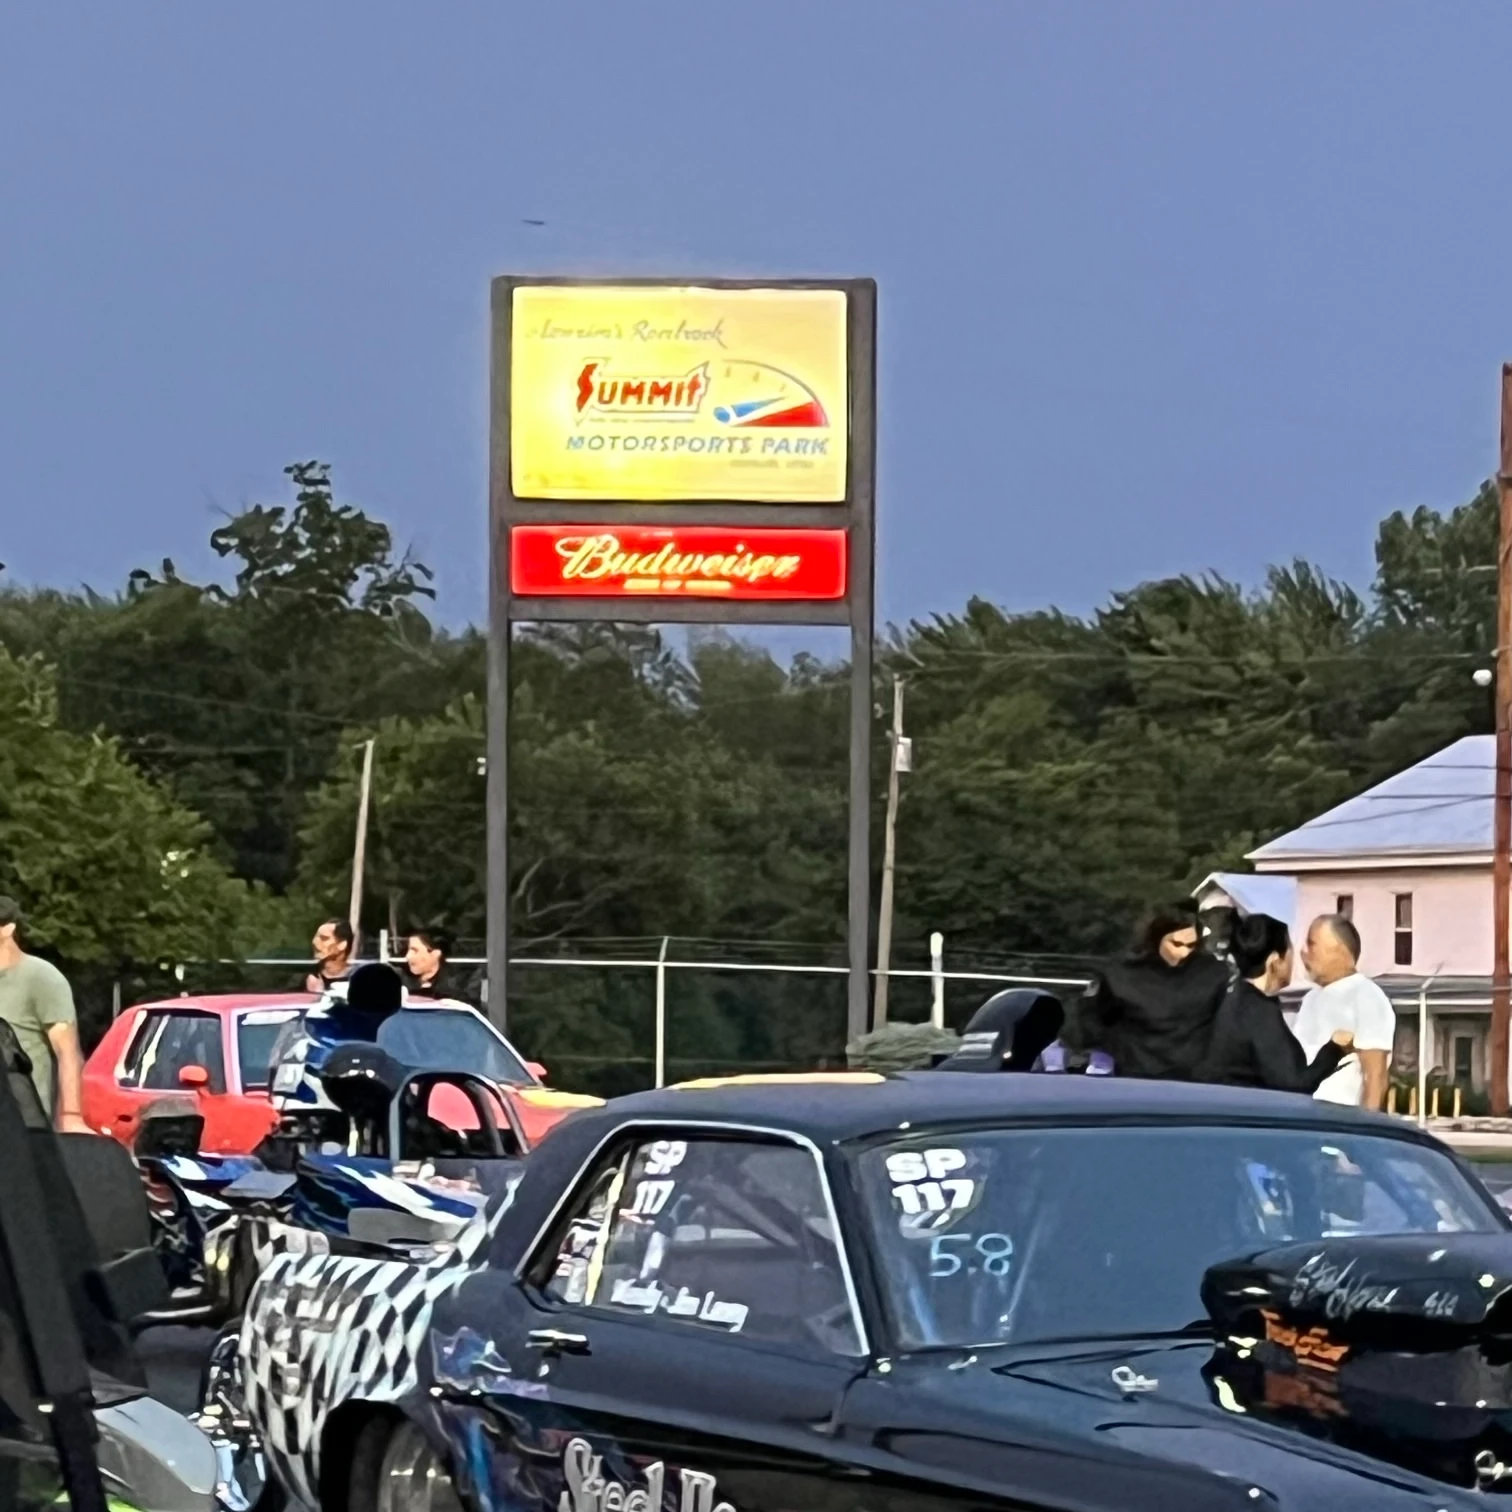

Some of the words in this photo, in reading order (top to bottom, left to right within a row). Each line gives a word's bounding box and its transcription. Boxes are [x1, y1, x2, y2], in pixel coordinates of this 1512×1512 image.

[565, 434, 752, 455] MOTORSPORTS
[760, 436, 830, 456] PARK
[554, 533, 801, 583] Budweiser
[885, 1148, 967, 1183] SP
[891, 1179, 975, 1215] 117
